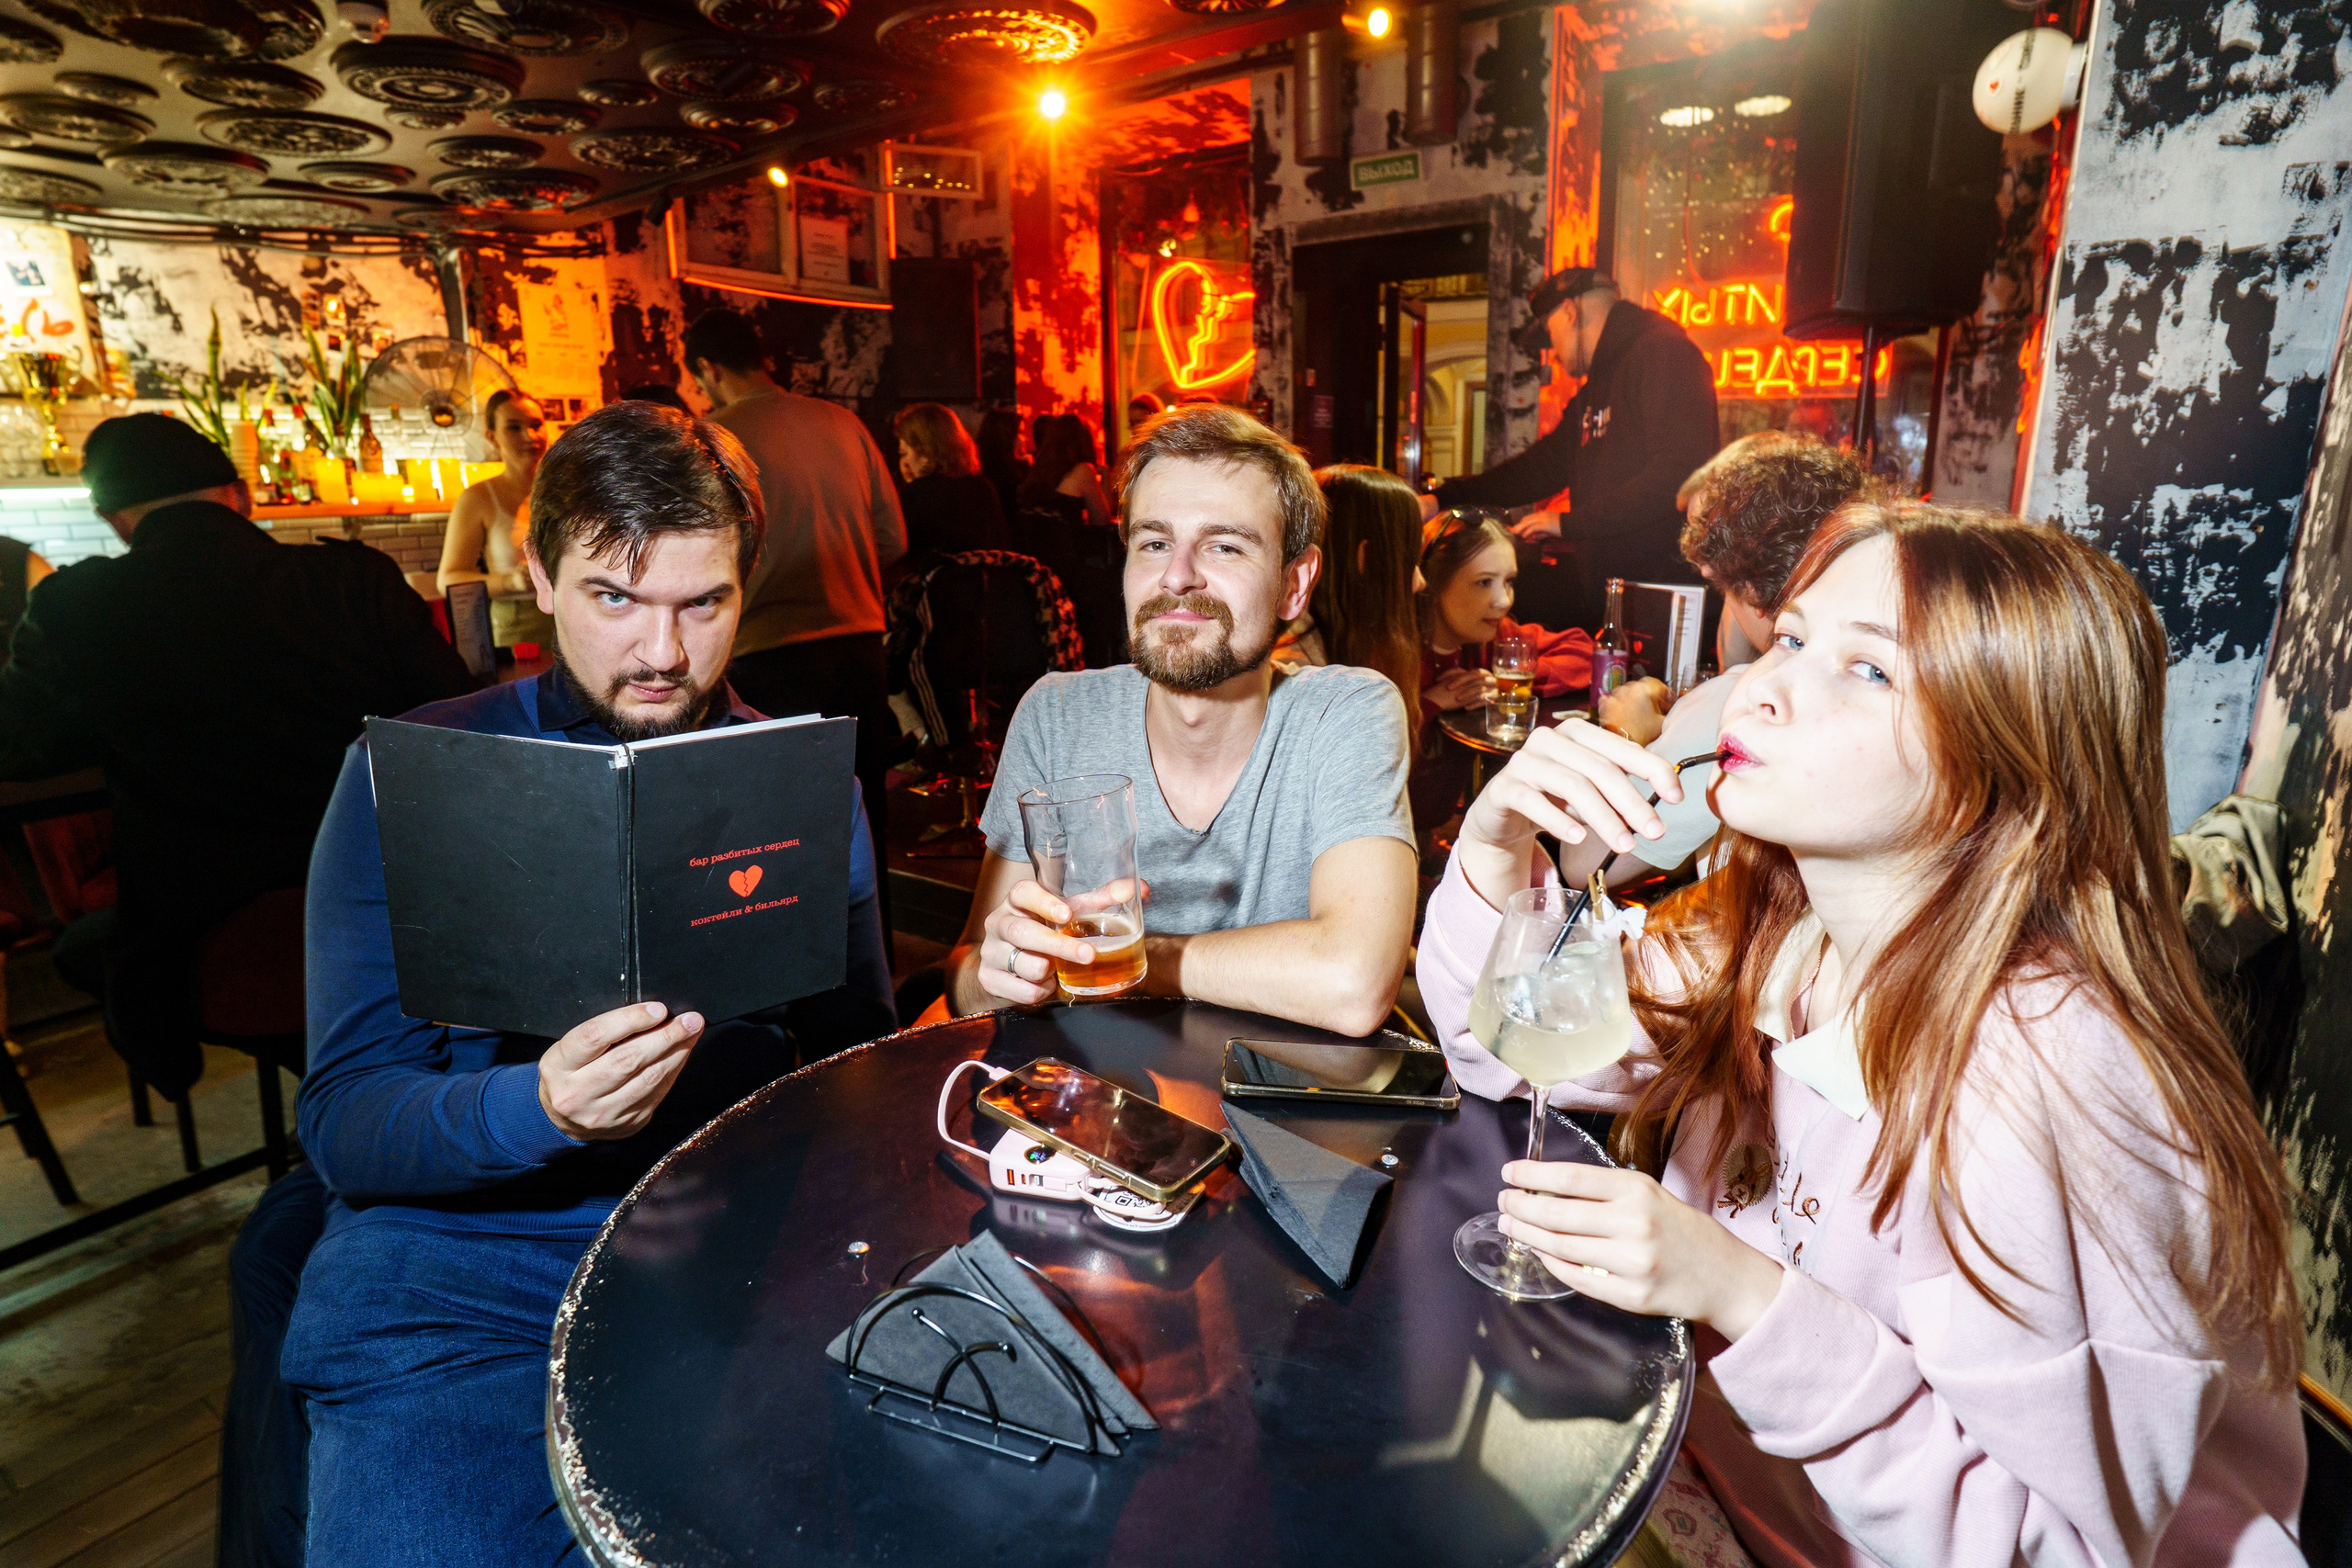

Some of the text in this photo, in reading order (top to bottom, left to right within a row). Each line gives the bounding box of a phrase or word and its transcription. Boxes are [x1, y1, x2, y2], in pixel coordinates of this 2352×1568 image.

[689, 838, 800, 867] бар разбитых сердец
[690, 896, 799, 927] коктейли & бильярд
